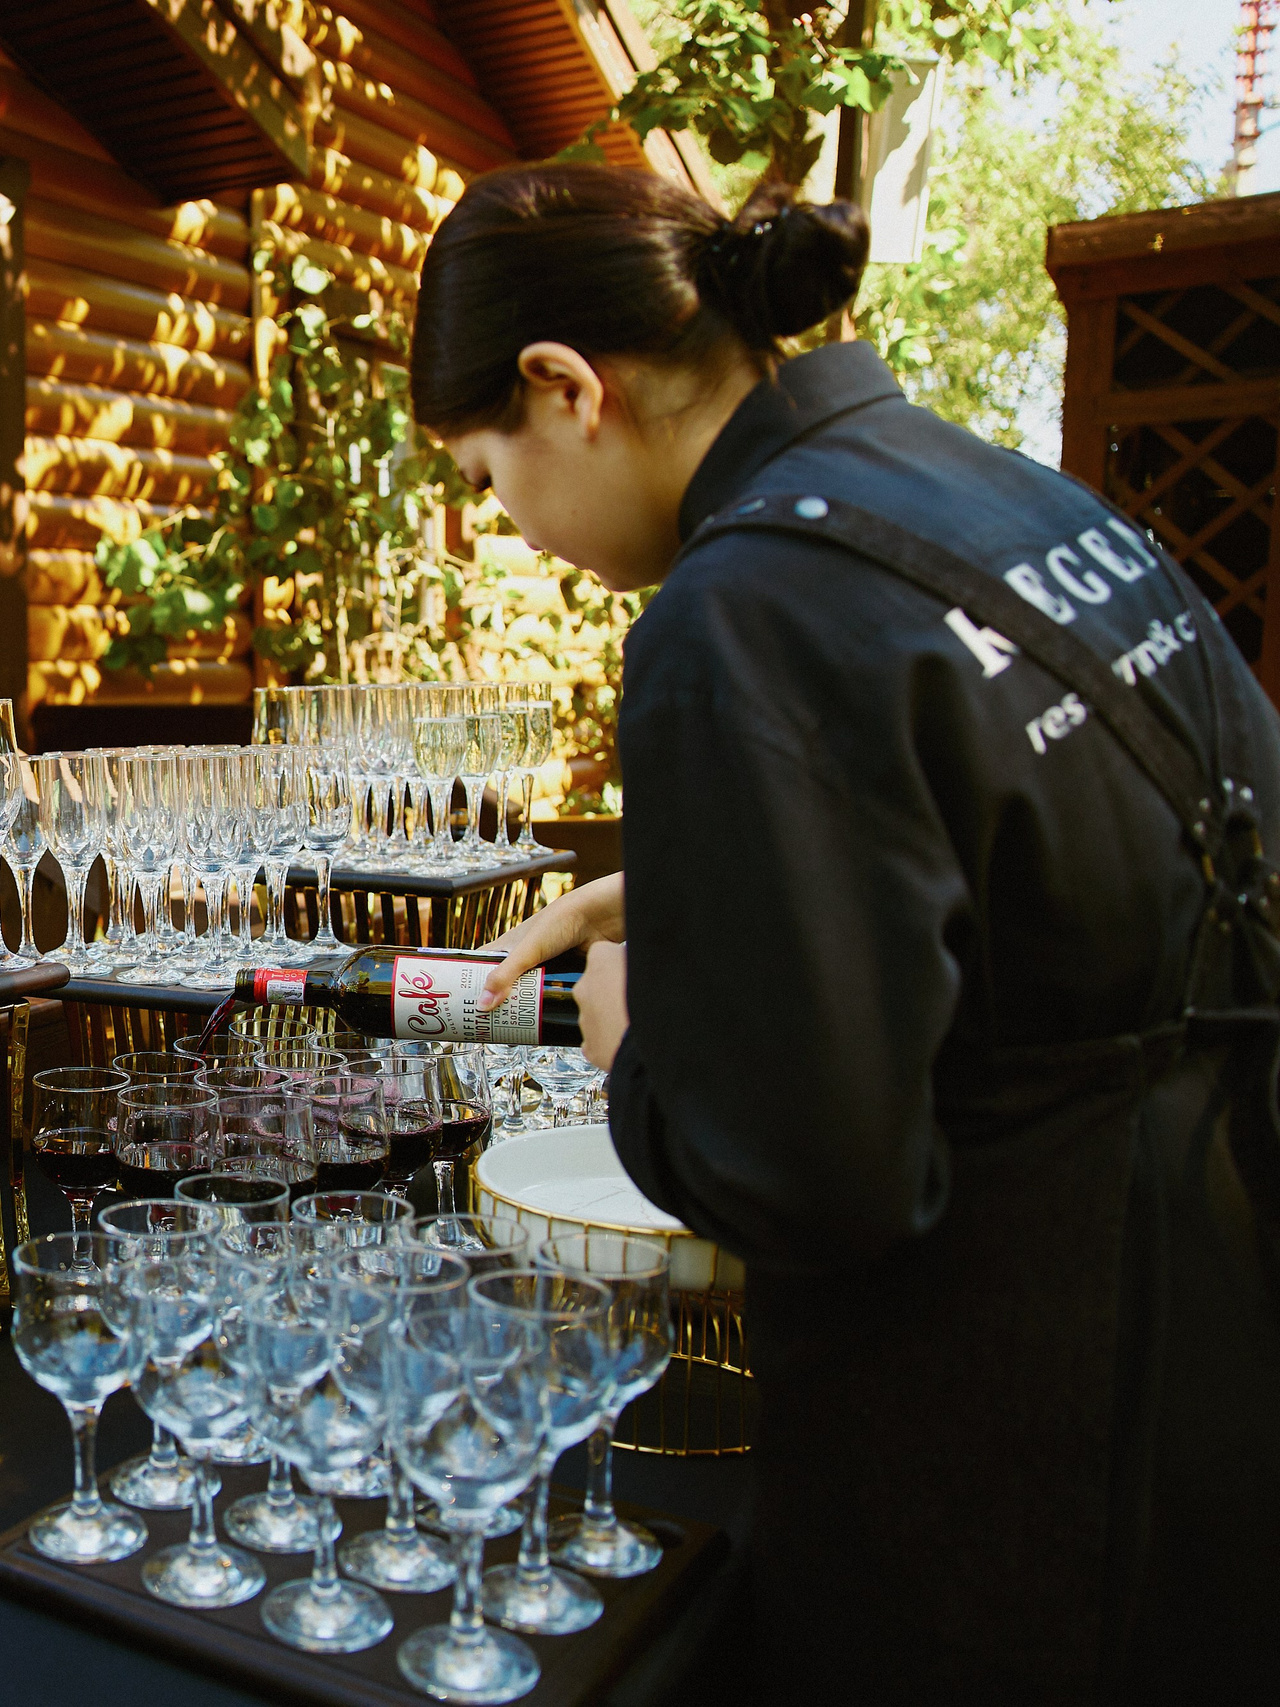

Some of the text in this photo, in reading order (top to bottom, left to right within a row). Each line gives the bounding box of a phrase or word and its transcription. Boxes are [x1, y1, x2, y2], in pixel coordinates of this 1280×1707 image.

[460, 968, 468, 989] 2021
[398, 969, 453, 1036] Café
[443, 1000, 458, 1035] CULTURE
[463, 999, 475, 1041] COFFEE
[510, 1004, 518, 1025] SOFT
